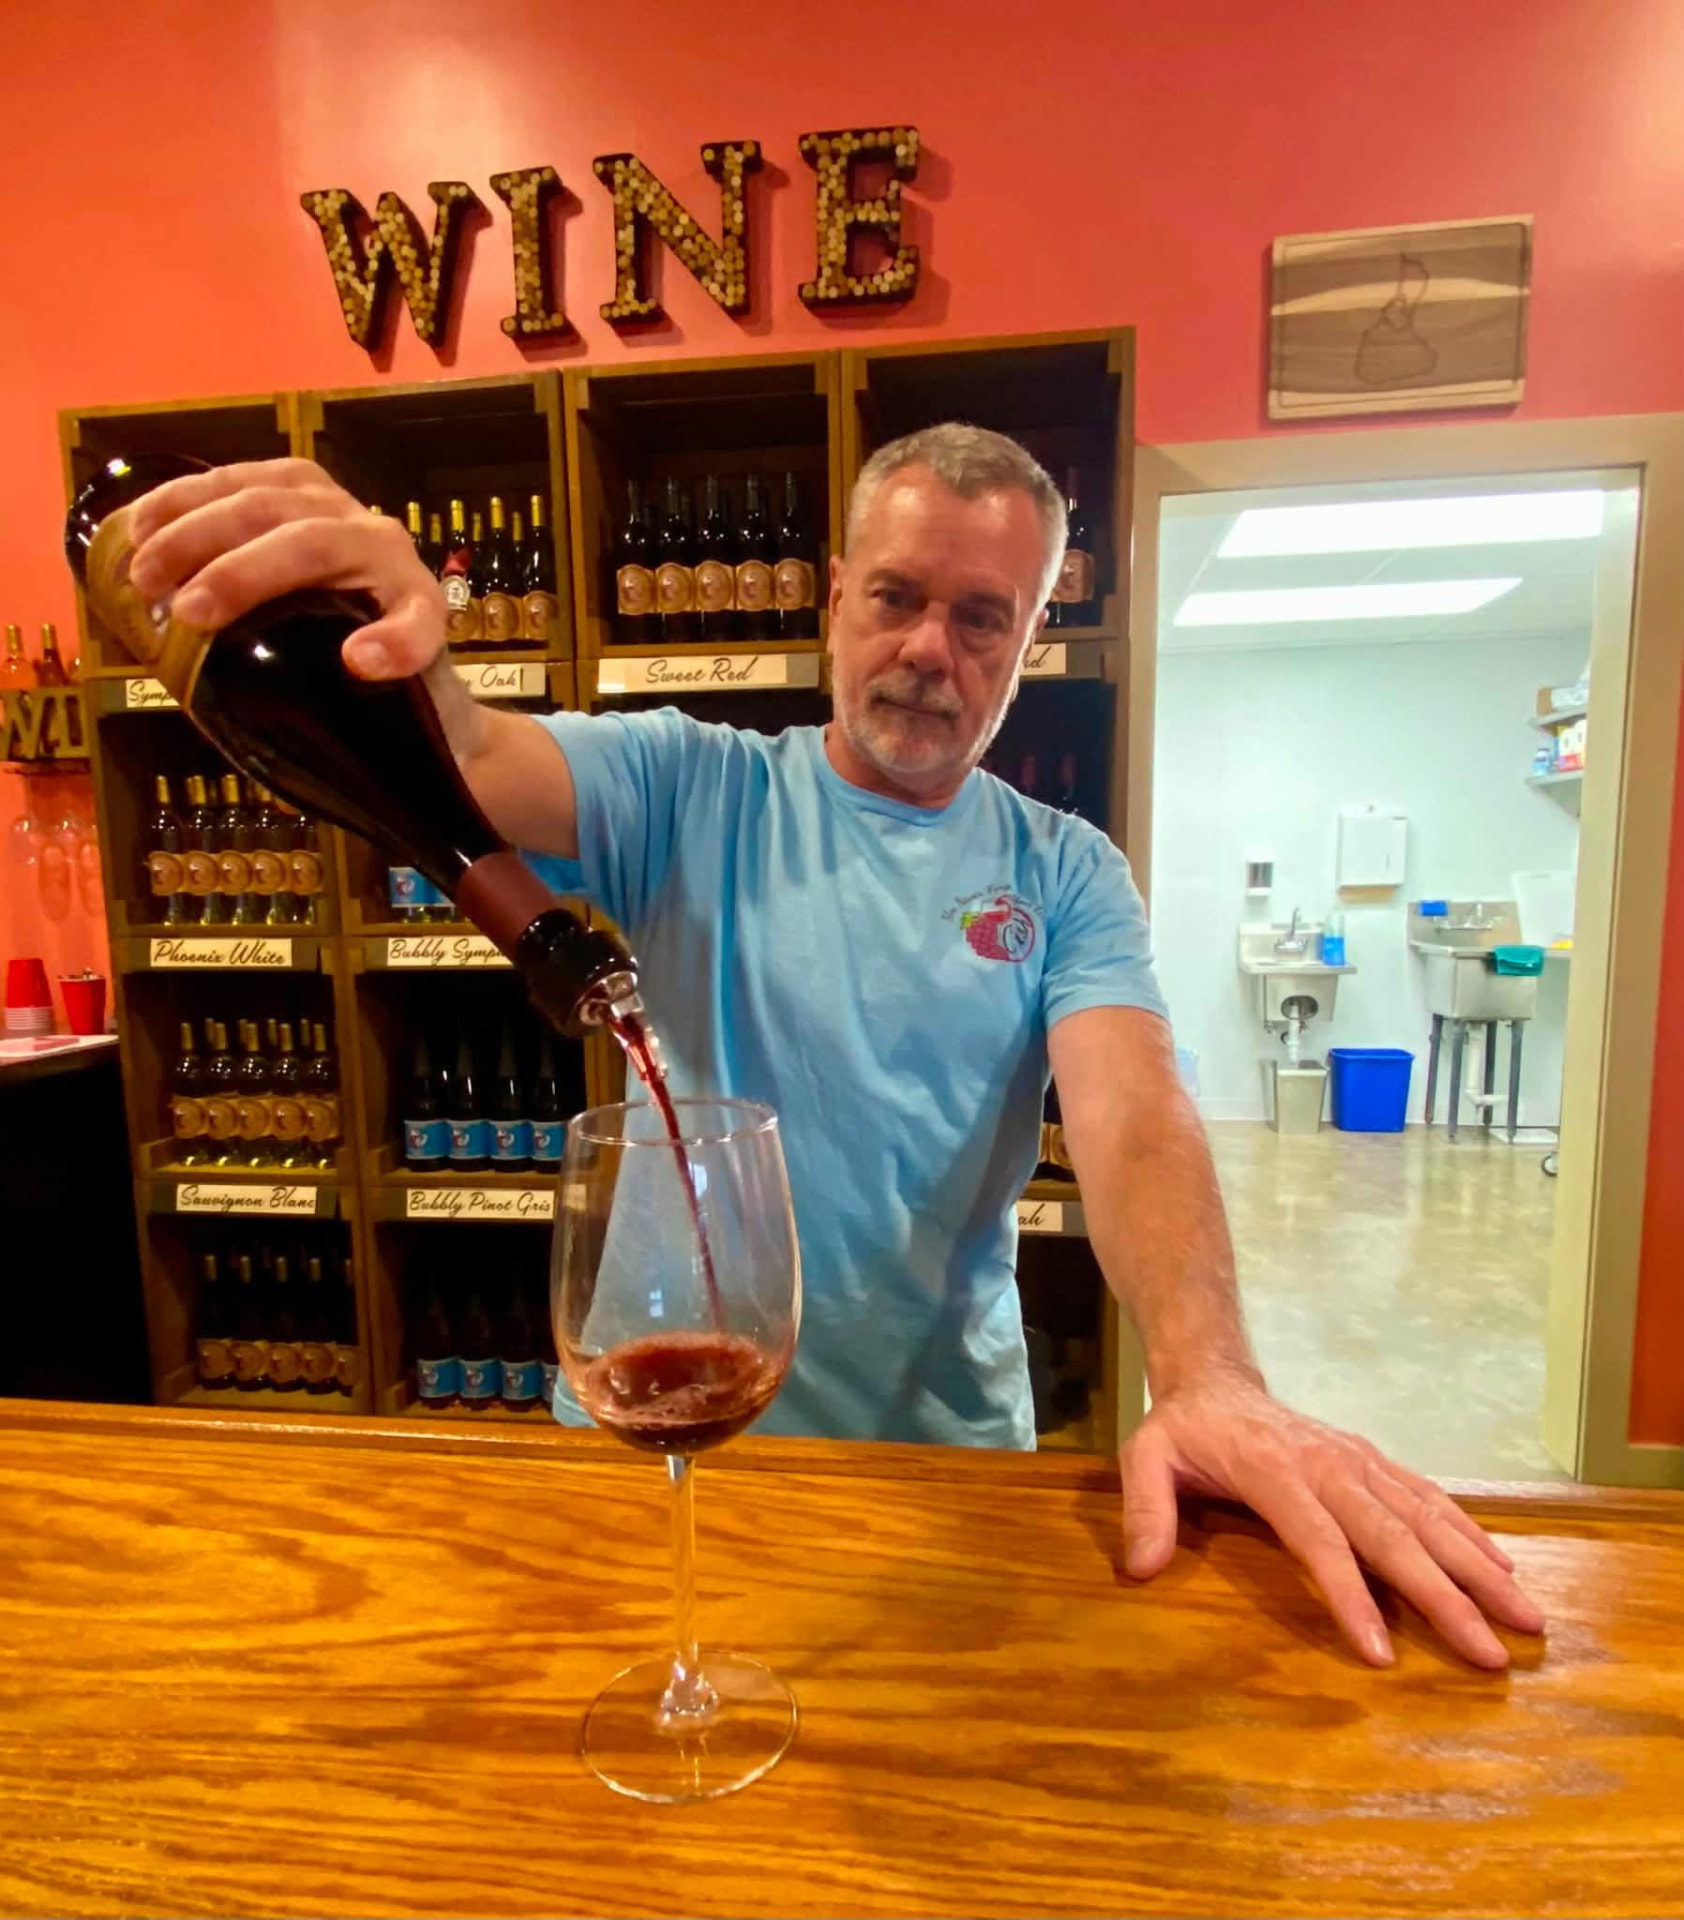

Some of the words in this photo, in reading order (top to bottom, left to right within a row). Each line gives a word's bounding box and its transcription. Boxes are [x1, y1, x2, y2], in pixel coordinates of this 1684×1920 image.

[300, 125, 920, 351] WINE
[645, 658, 705, 684] Sweet
[709, 655, 759, 682] Red
[153, 939, 225, 963] Phoenix
[229, 938, 286, 965] White
[389, 937, 447, 966] Bubbly
[180, 1183, 263, 1213] Sauvignon
[269, 1185, 315, 1209] Blanc
[408, 1190, 464, 1217] Bubbly
[467, 1191, 513, 1212] Pinot
[516, 1191, 551, 1216] Gris
